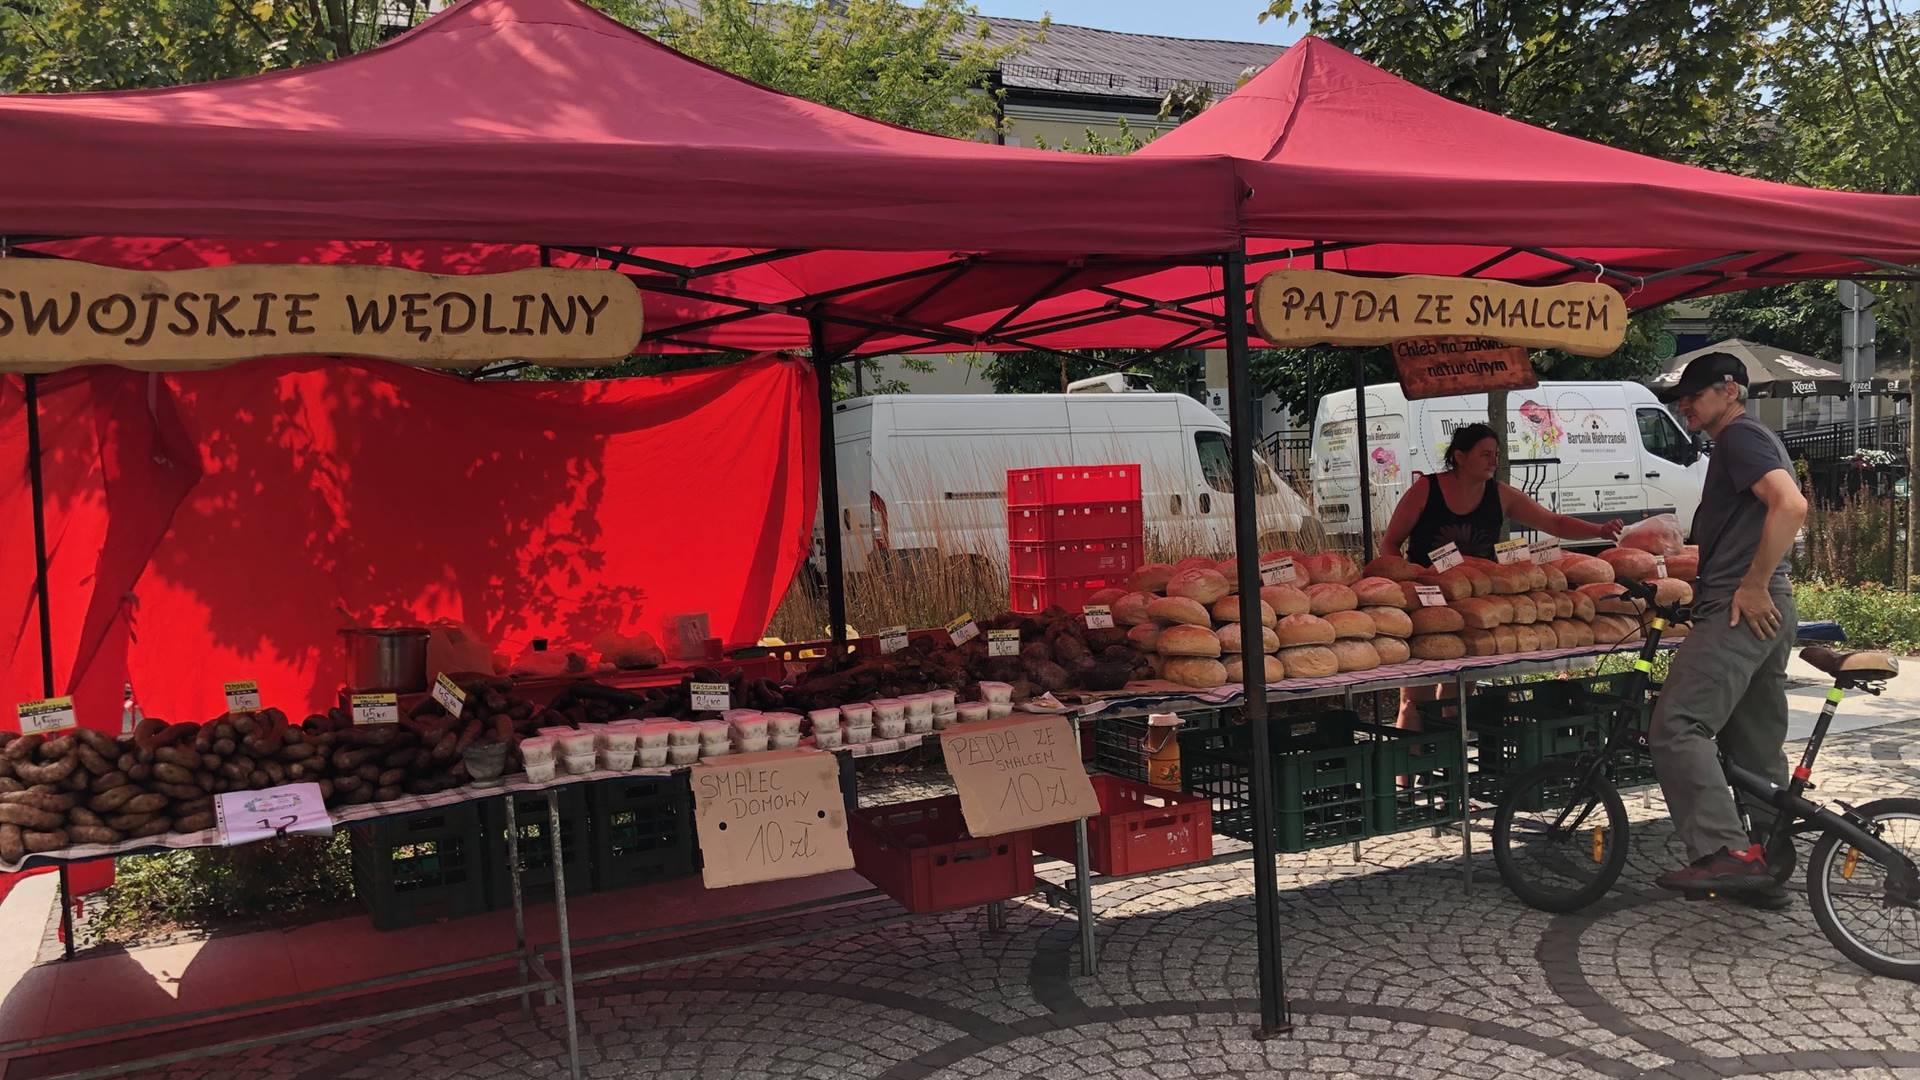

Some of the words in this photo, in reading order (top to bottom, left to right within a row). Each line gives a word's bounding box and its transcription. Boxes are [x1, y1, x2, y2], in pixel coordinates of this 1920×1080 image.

[0, 288, 320, 346] SWOJSKIE
[346, 291, 609, 343] WĘDLINY
[1282, 287, 1400, 329] PAJDA
[1414, 293, 1453, 325] ZE
[1465, 295, 1609, 331] SMALCEM
[1440, 342, 1458, 355] na
[1427, 359, 1508, 377] naturalnym
[1792, 381, 1817, 393] Kozel
[1567, 432, 1591, 444] Bartnik
[948, 731, 1020, 765] PAJDA
[1033, 727, 1056, 746] ZE
[996, 751, 1055, 771] SMALCEM
[700, 770, 783, 798] SMALEC
[1000, 773, 1044, 816] 10
[728, 791, 810, 819] DOMOWY
[746, 821, 784, 865] 10
